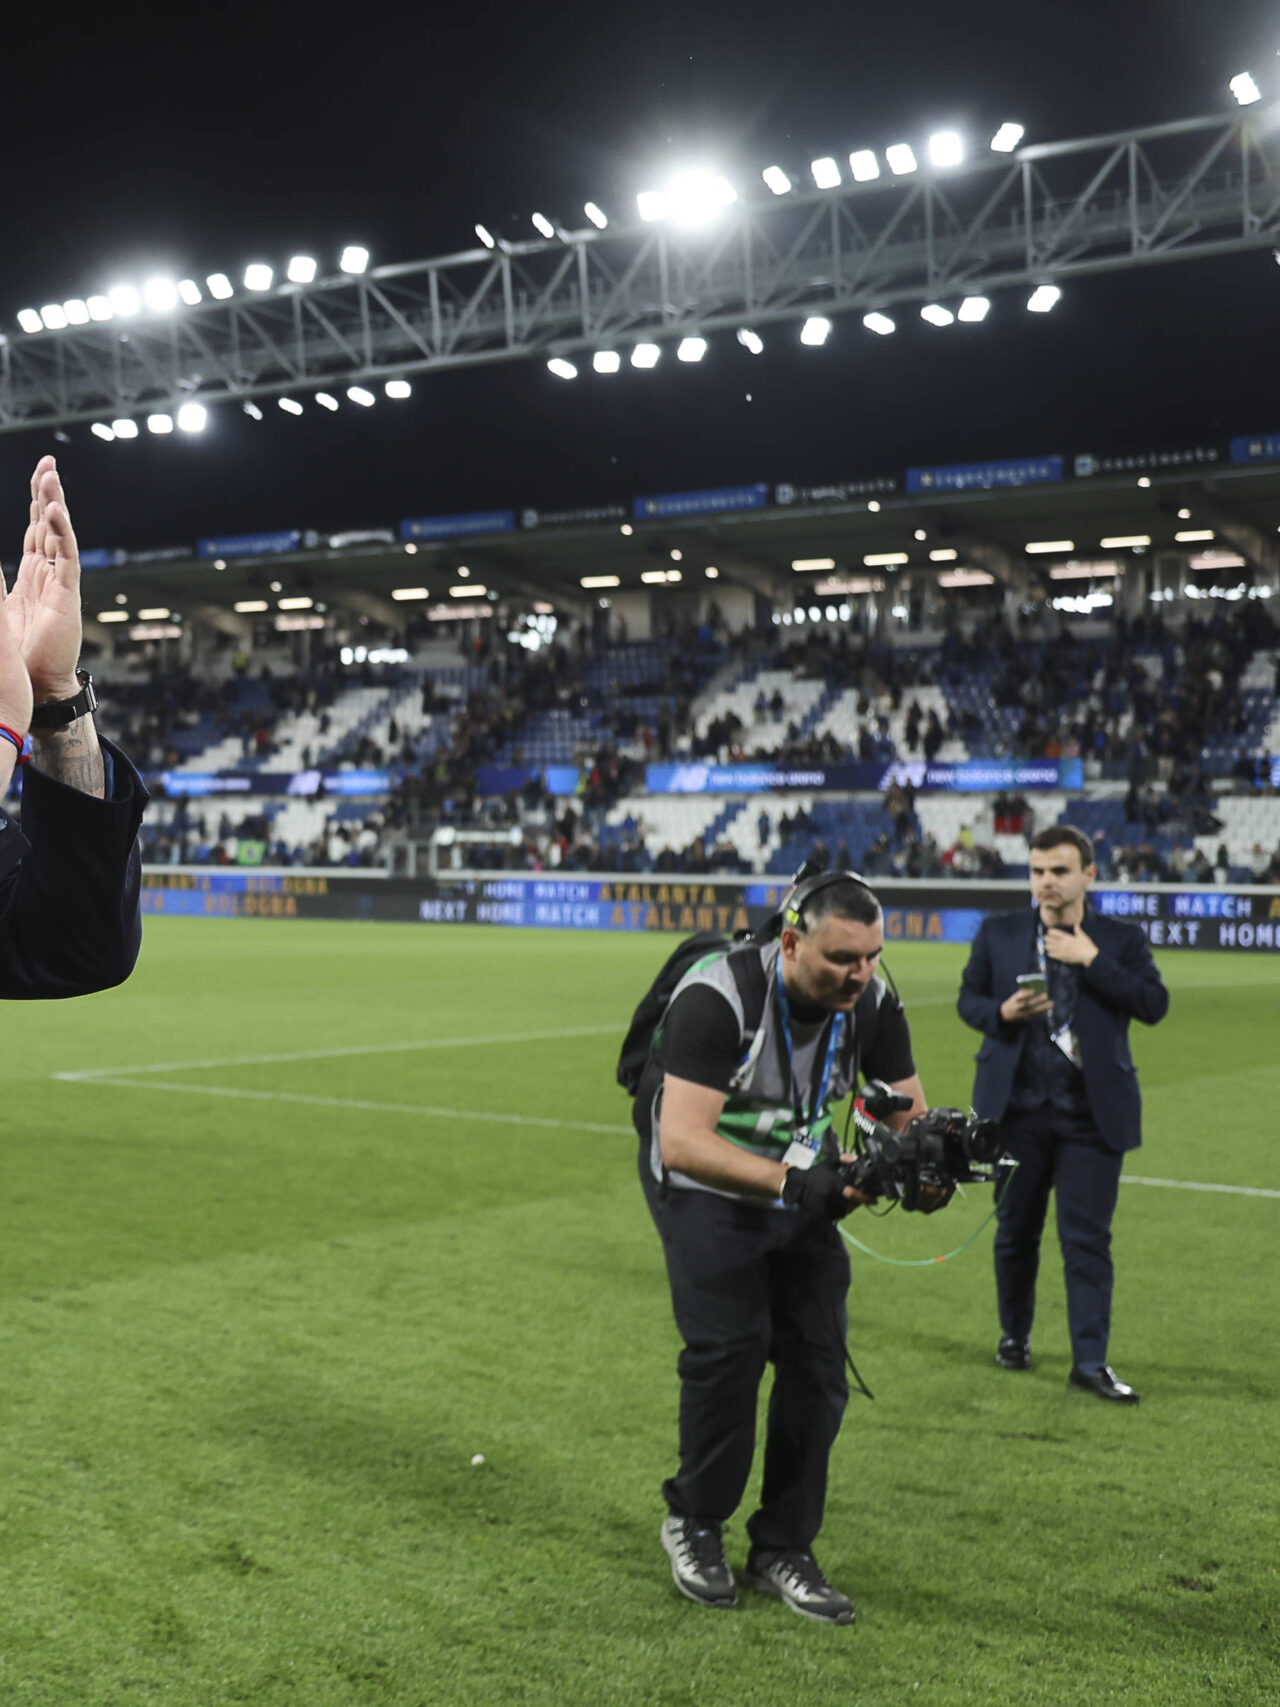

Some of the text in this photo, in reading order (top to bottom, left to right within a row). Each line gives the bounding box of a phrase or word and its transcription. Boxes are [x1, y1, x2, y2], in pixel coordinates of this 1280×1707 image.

[599, 882, 717, 904] ATALANTA
[1100, 892, 1160, 916] HOME
[1174, 894, 1253, 918] MATCH
[421, 901, 467, 922] NEXT
[534, 903, 600, 926] MATCH
[610, 905, 750, 930] ATALANTA
